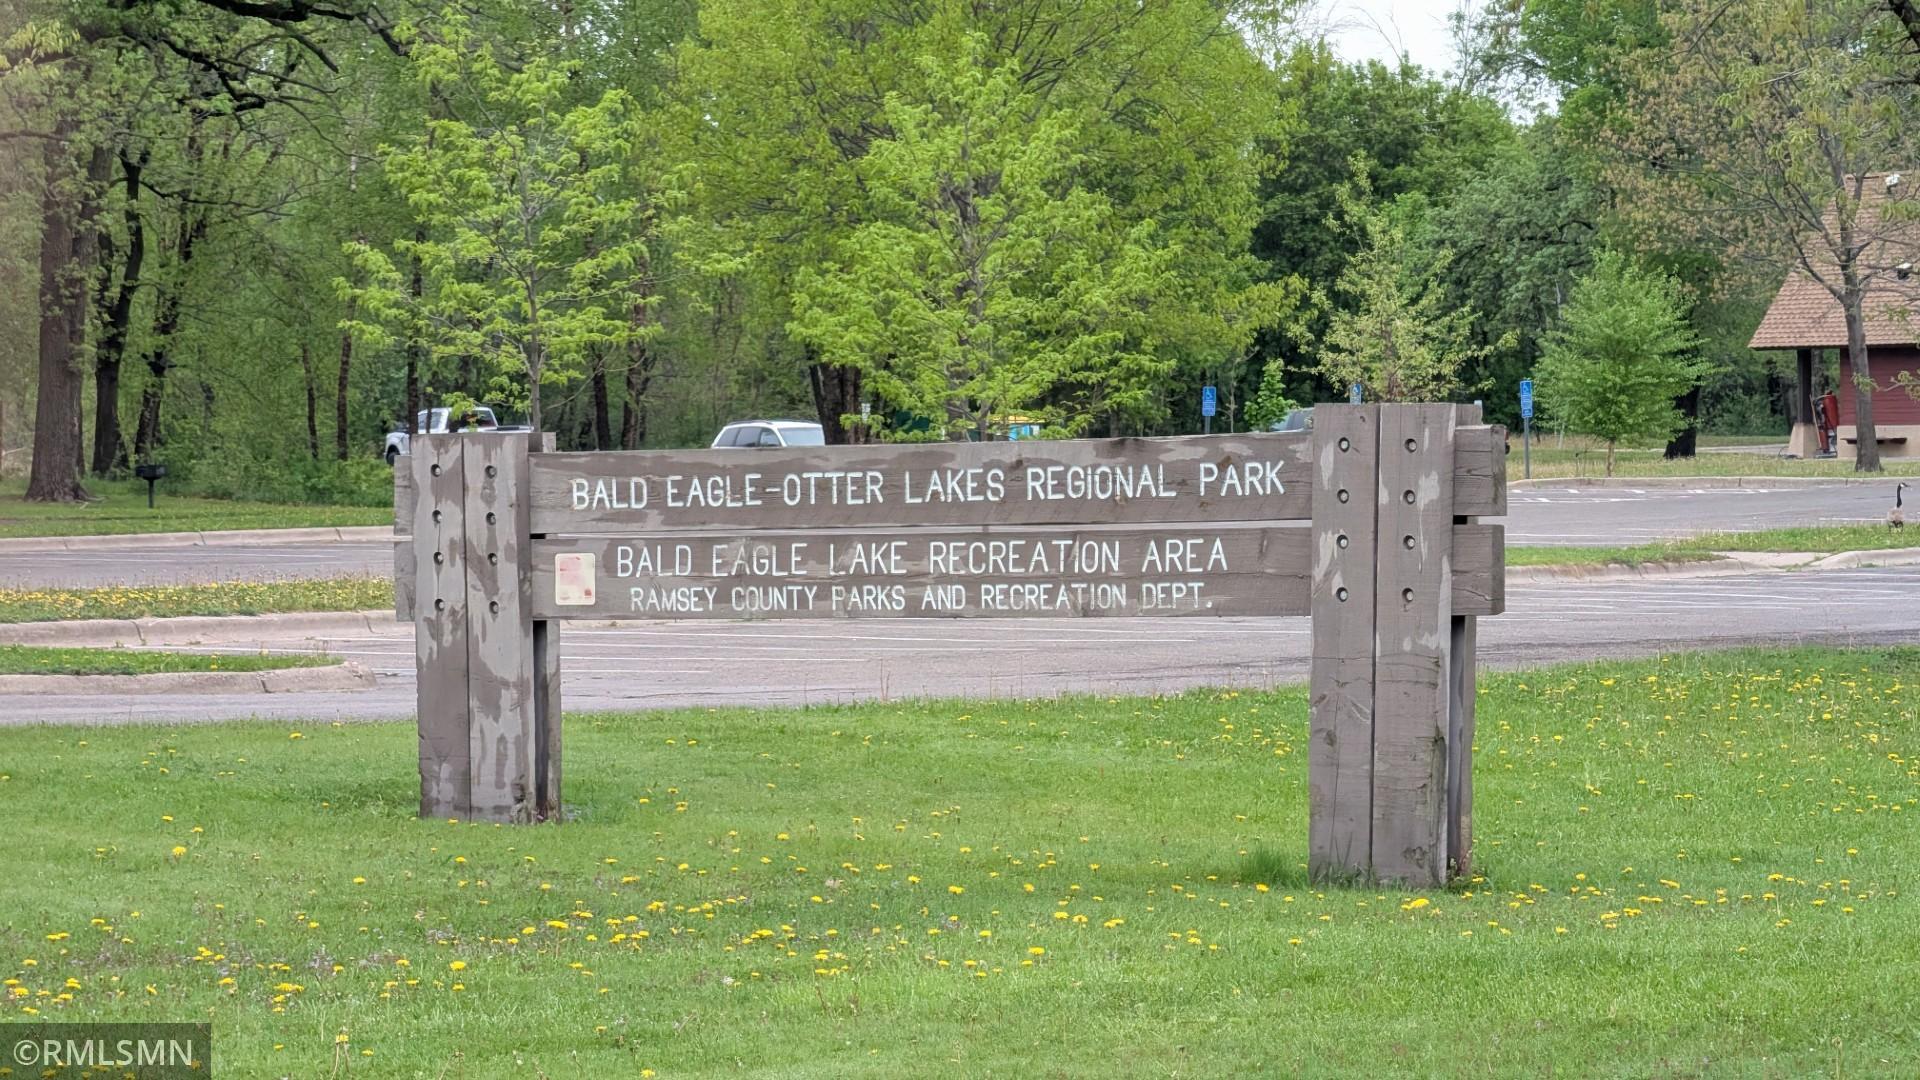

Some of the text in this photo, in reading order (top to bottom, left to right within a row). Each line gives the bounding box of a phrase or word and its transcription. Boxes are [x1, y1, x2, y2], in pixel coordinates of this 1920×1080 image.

[571, 459, 1286, 511] BALD EAGLE-OTTER LAKES REGIONAL PARK
[616, 536, 1229, 578] BALD EAGLE LAKE RECREATION AREA
[629, 581, 1214, 613] RAMSEY COUNTY PARKS AND RECREATION DEPT.
